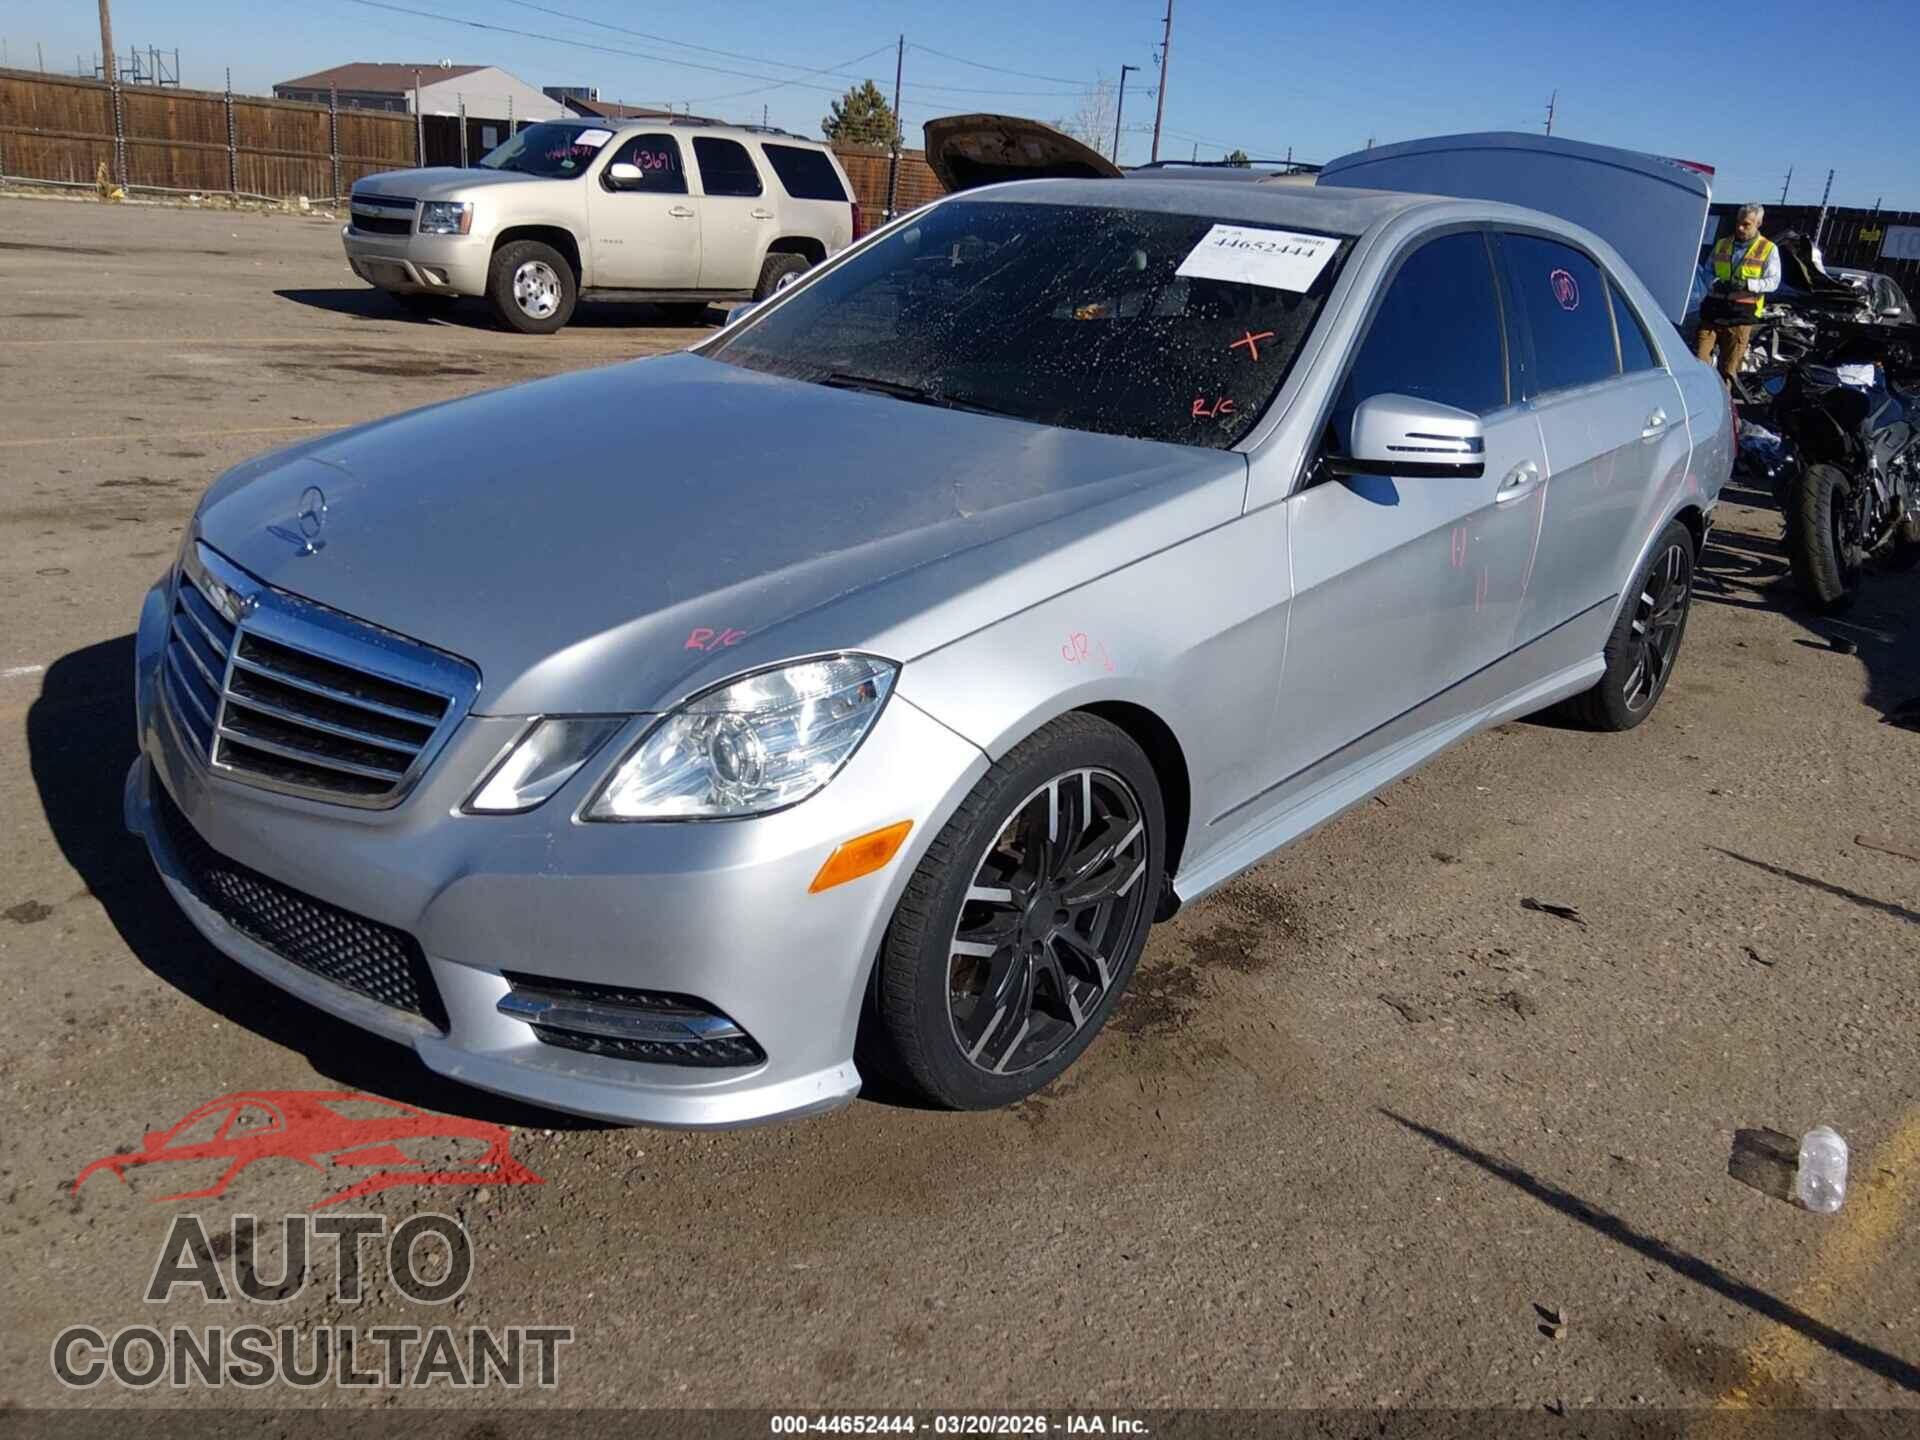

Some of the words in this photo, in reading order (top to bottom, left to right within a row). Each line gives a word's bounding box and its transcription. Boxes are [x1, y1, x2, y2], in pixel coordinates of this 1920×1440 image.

[632, 148, 676, 171] 63691
[1213, 237, 1317, 258] 44652444
[1192, 398, 1234, 418] R/C
[684, 626, 747, 651] R/C
